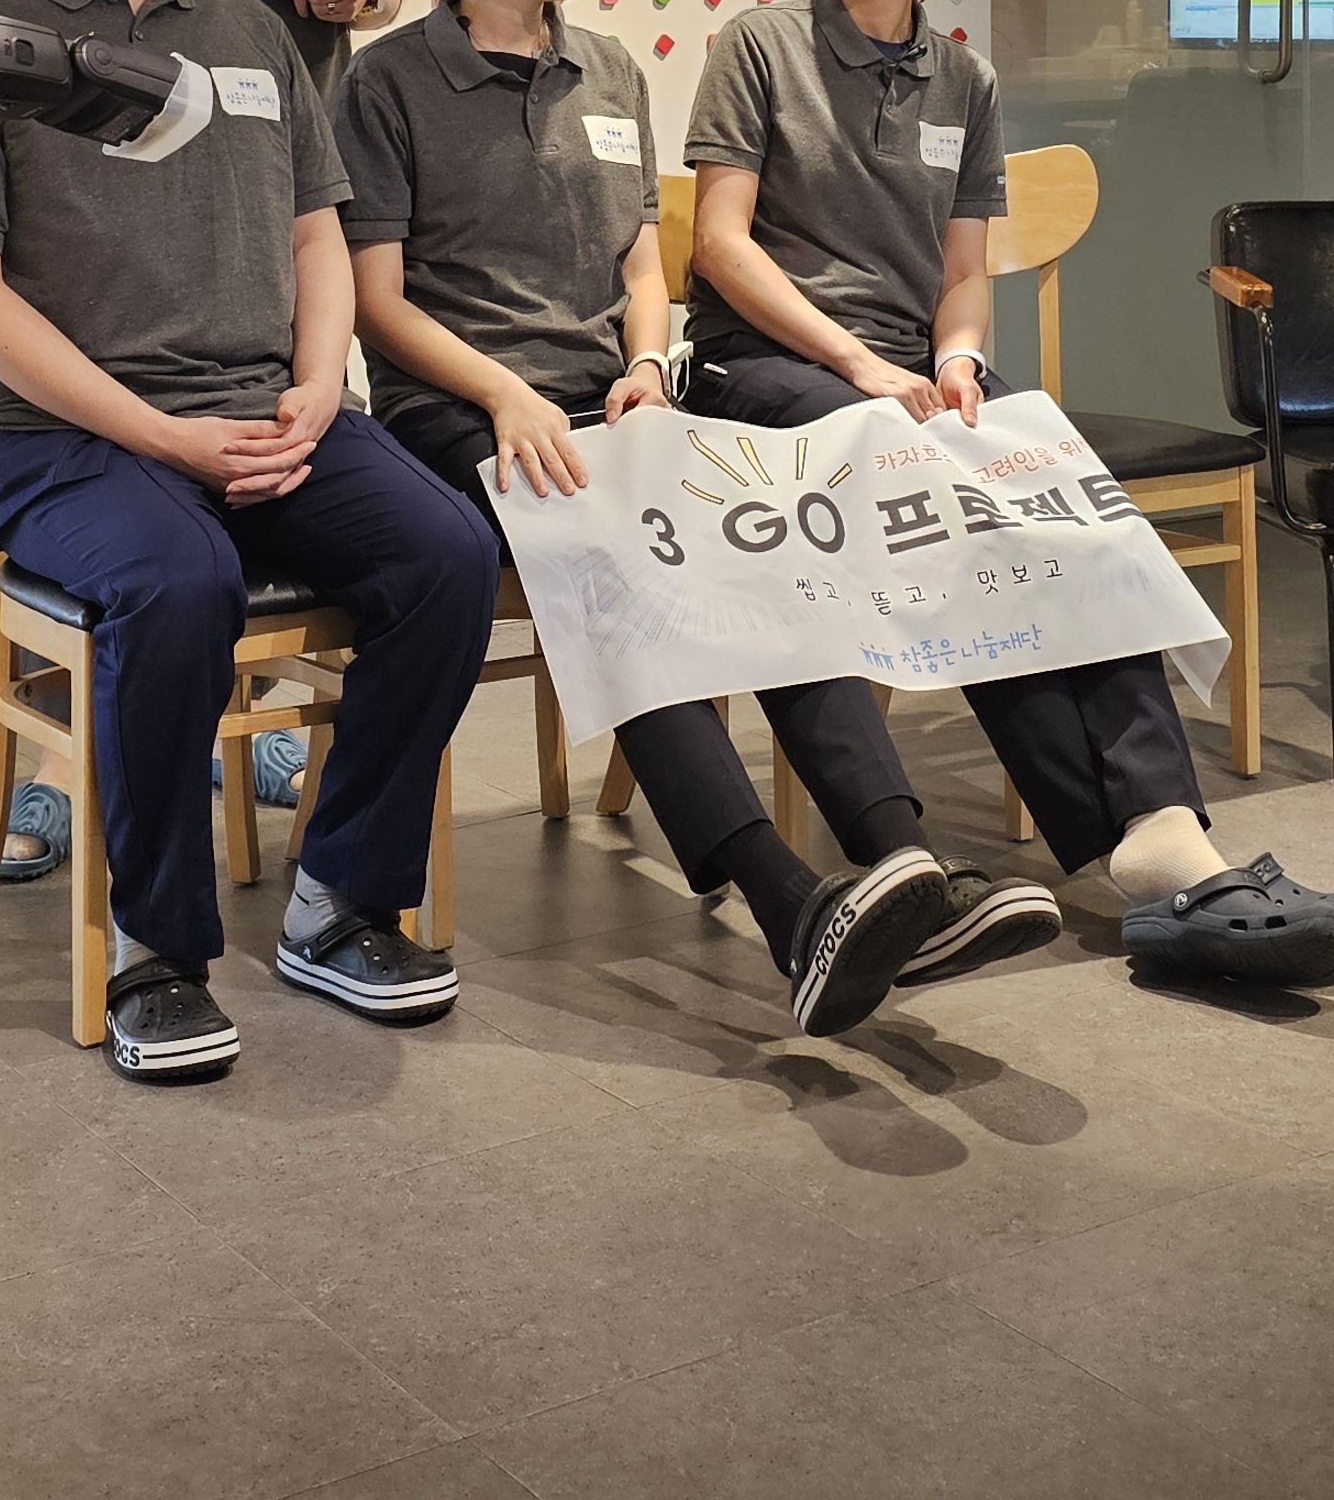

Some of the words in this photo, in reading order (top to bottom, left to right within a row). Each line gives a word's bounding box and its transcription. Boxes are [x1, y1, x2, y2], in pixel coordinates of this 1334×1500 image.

[641, 507, 685, 566] 3
[722, 492, 846, 554] GO
[875, 473, 1146, 555] 프로젝트
[814, 902, 857, 976] crocs
